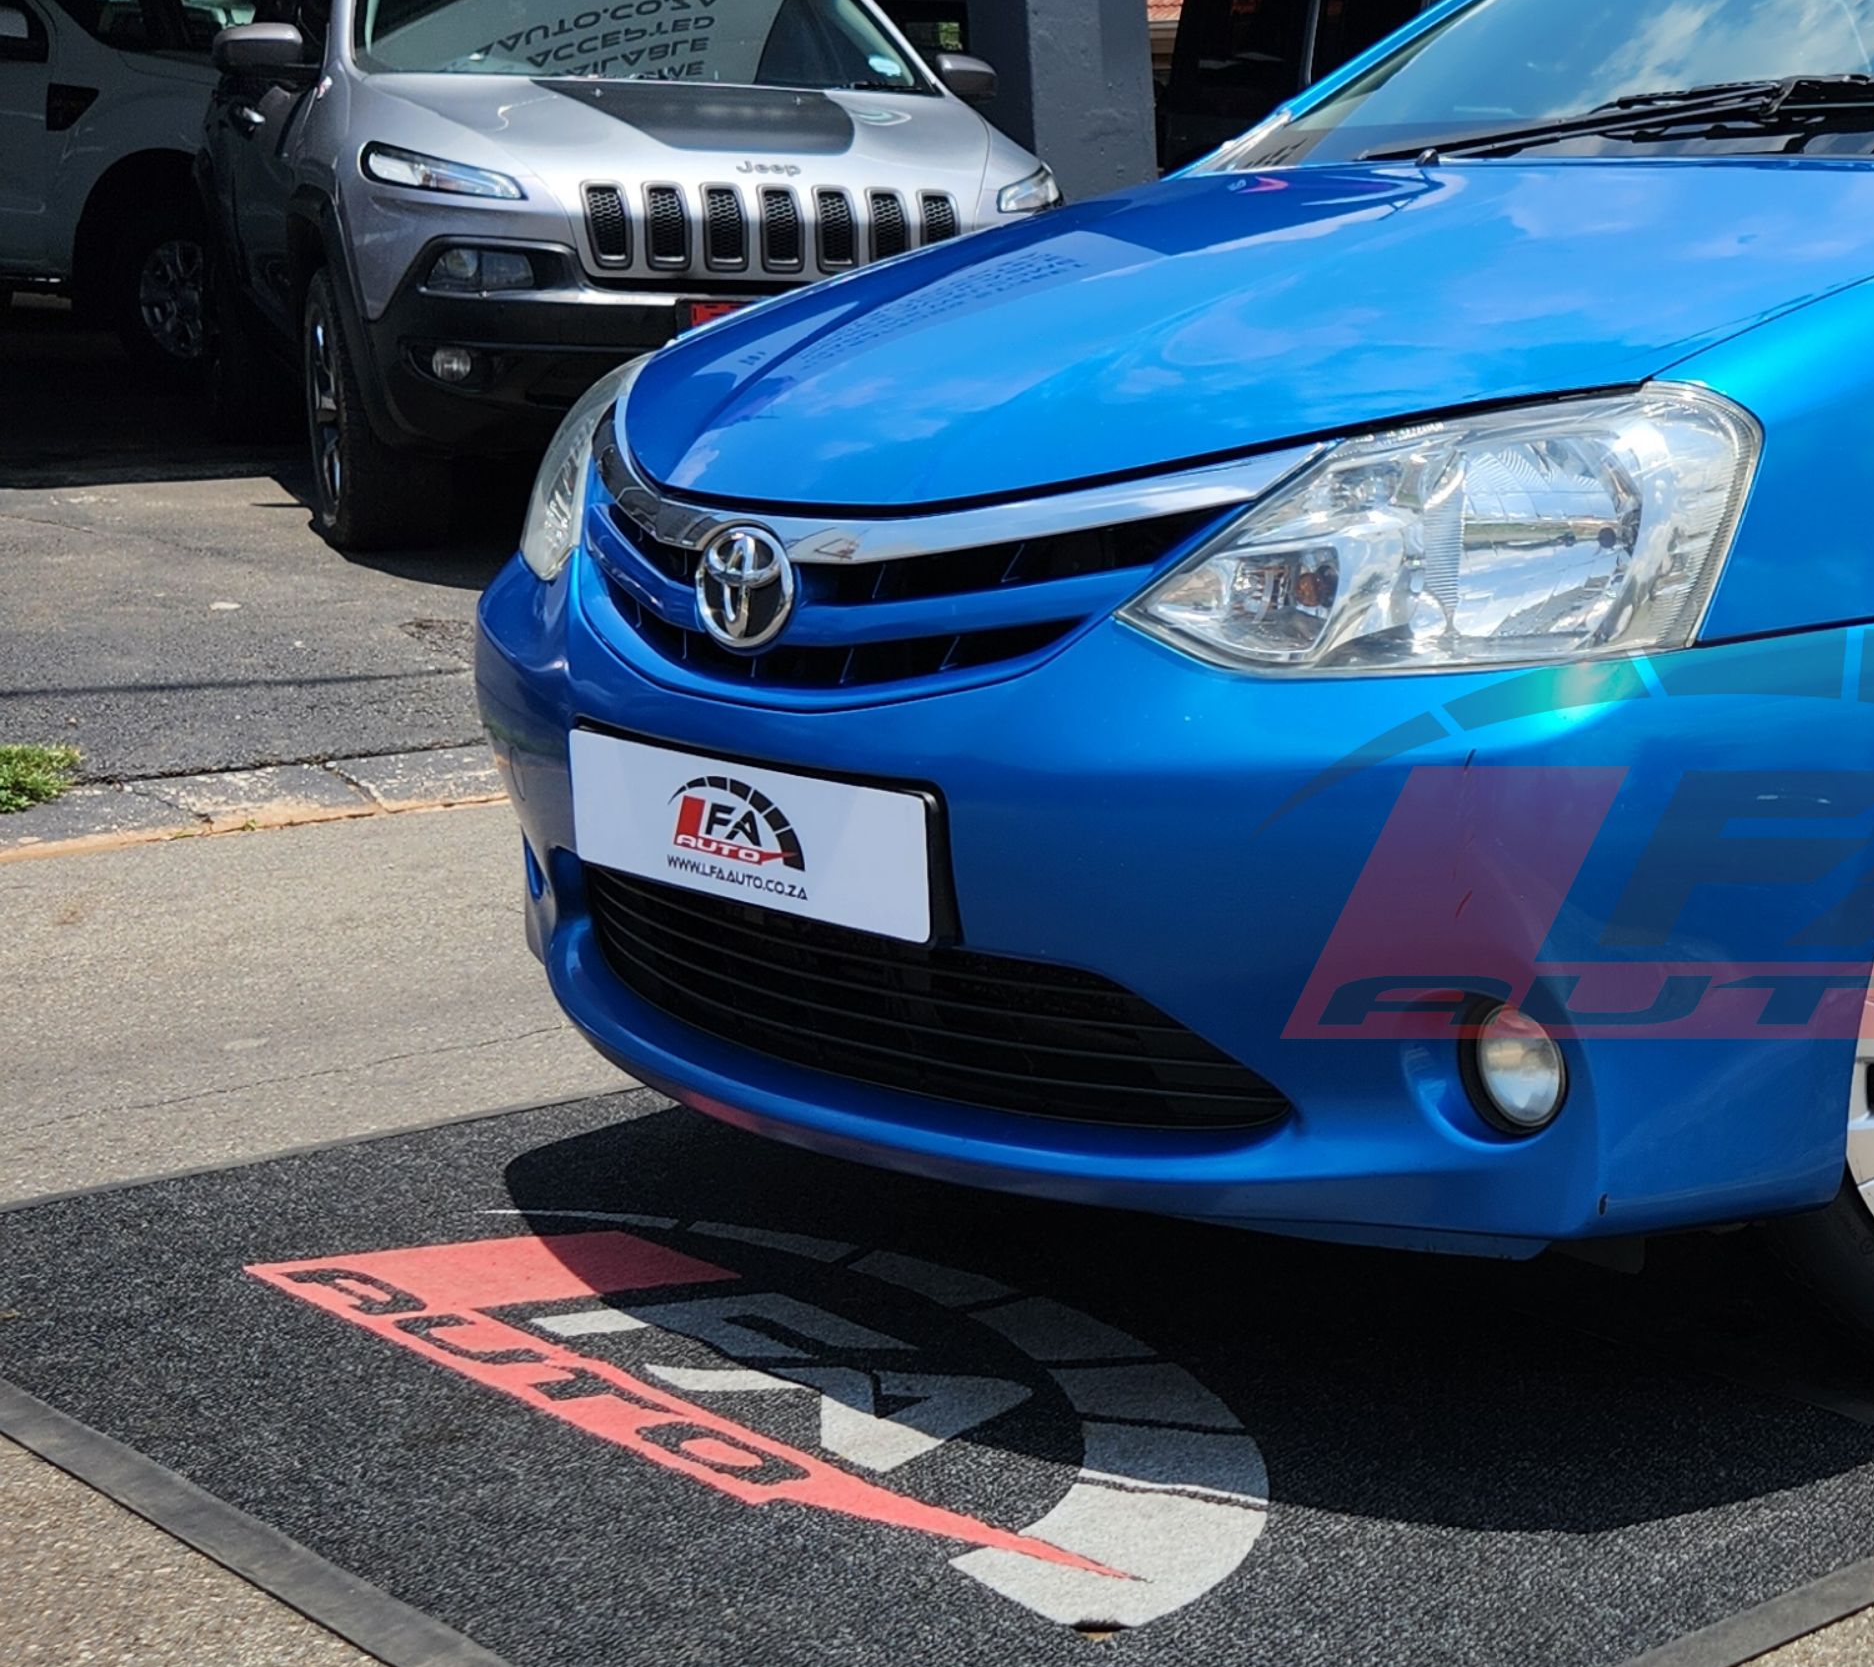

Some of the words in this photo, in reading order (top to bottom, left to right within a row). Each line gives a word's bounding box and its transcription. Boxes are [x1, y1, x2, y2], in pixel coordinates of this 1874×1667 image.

[735, 159, 802, 178] Jeep
[674, 794, 763, 848] LFA
[675, 834, 761, 863] AUTO
[666, 853, 808, 901] WWW.LFAAUTO.CO.ZA
[290, 1266, 813, 1488] AUTO
